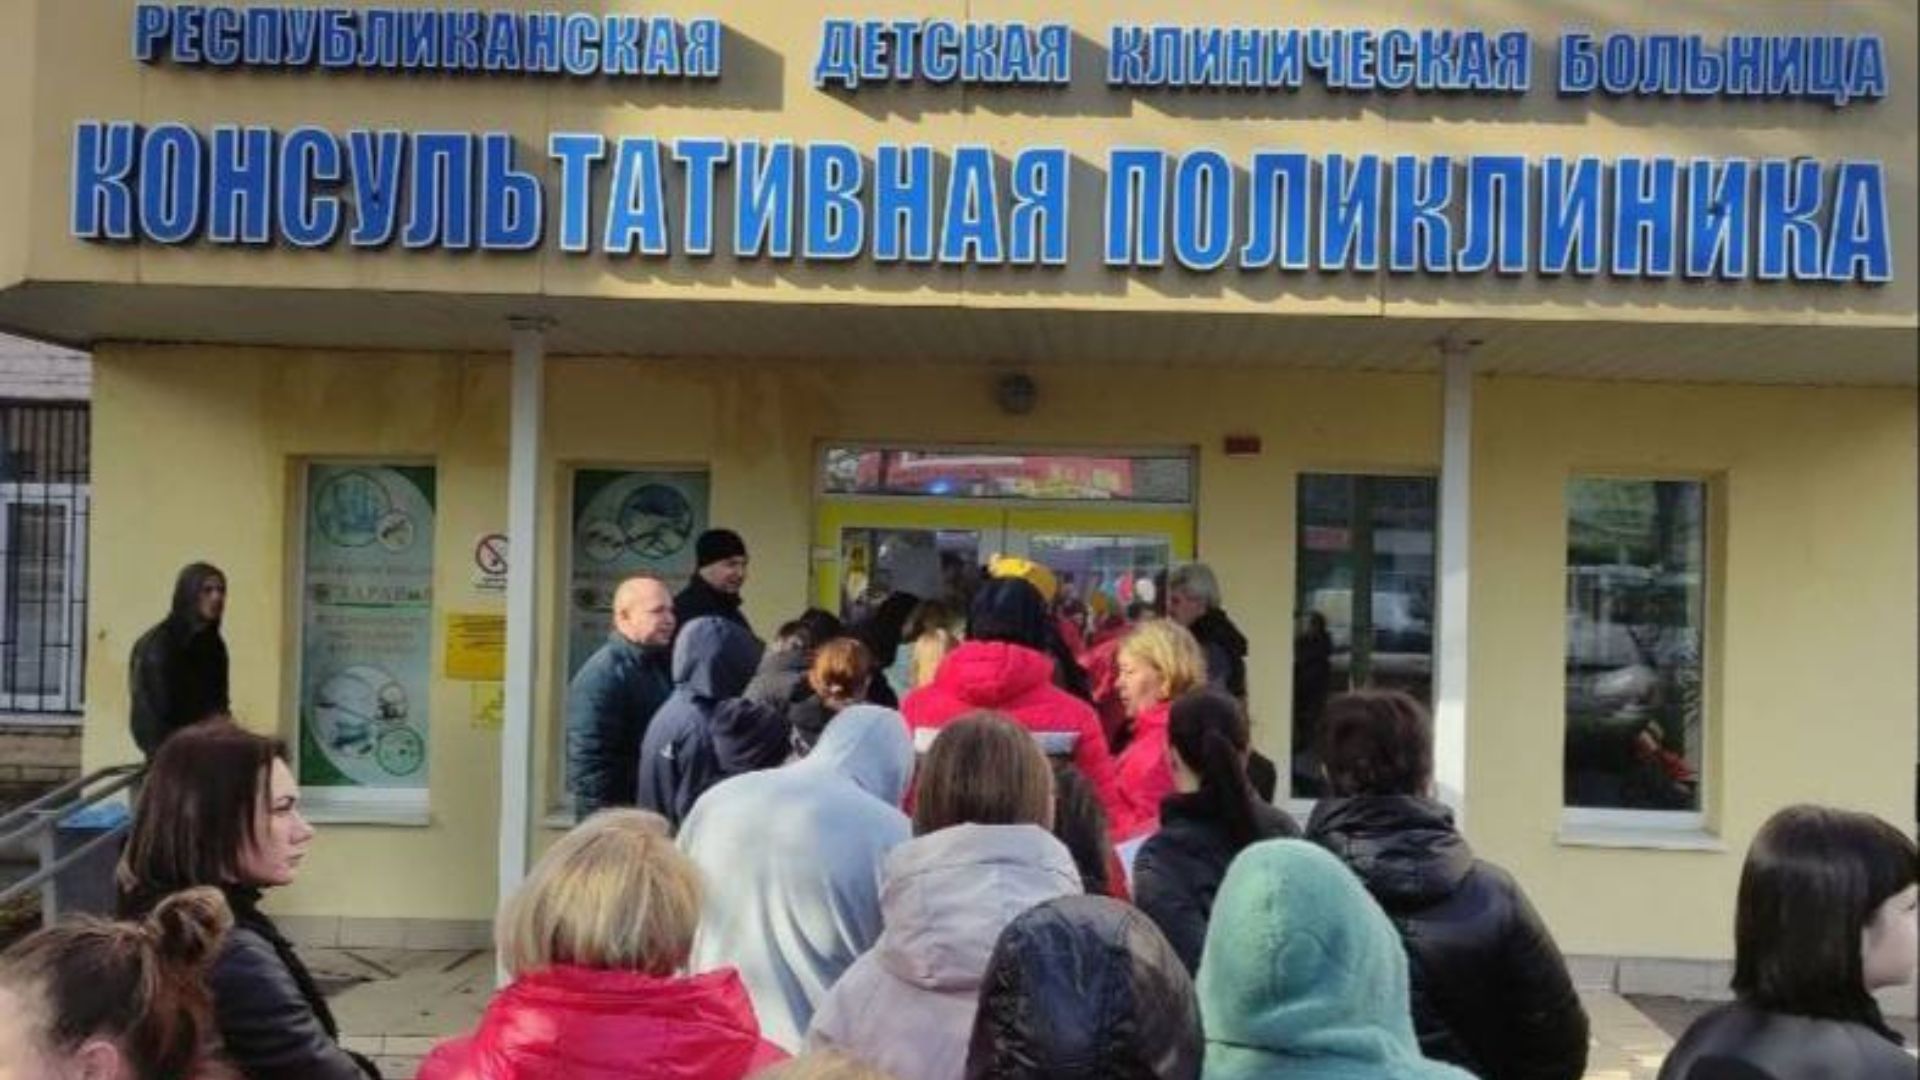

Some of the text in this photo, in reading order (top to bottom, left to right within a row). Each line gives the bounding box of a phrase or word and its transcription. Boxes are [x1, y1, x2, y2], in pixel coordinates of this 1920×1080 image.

[135, 4, 1887, 105] РЕСПУБЛИКАНСКАЯ ДЕТСКАЯ КЛИНИЧЕСКАЯ БОЛЬНИЦА
[72, 120, 1892, 282] КОНСУЛЬТАТИВНАЯ ПОЛИКЛИНИКА
